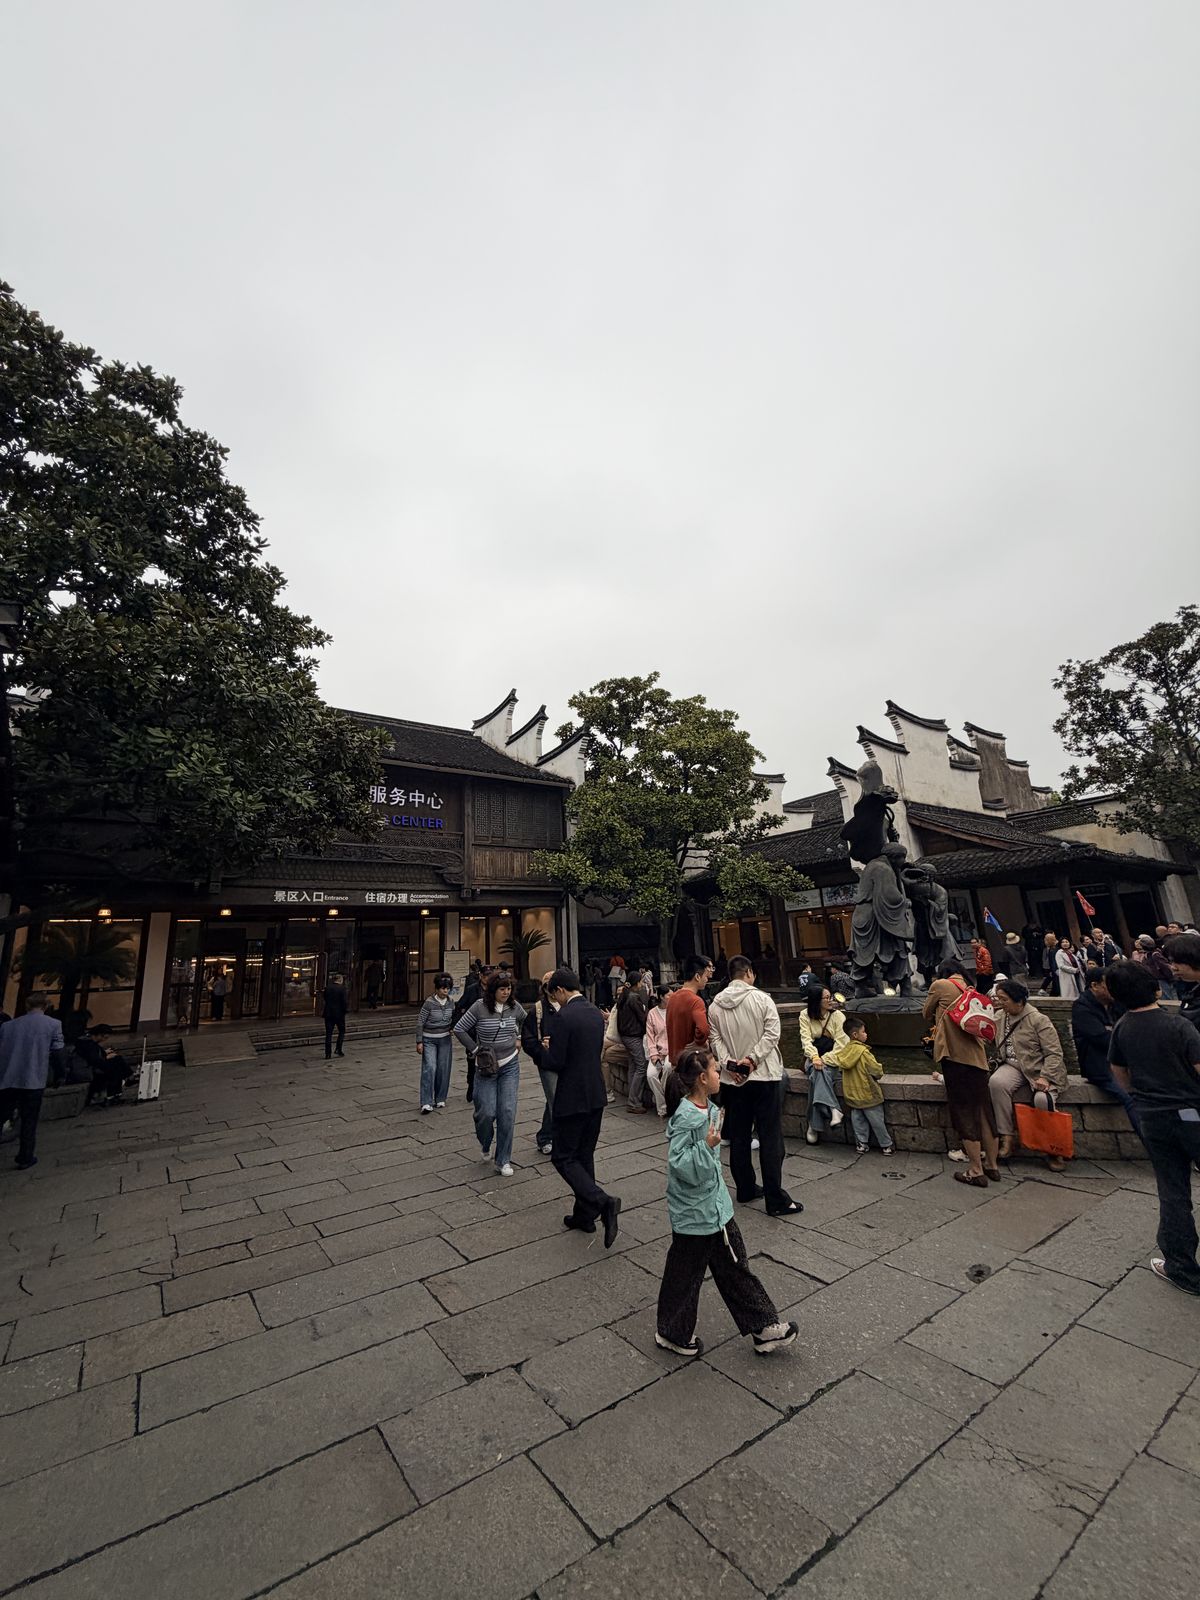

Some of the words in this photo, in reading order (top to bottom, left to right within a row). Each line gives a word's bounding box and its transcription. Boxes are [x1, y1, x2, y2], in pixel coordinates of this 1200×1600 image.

[369, 785, 444, 810] 服务中心
[392, 815, 444, 829] CENTER
[273, 890, 324, 903] 景区入口
[364, 892, 408, 904] 住宿办理
